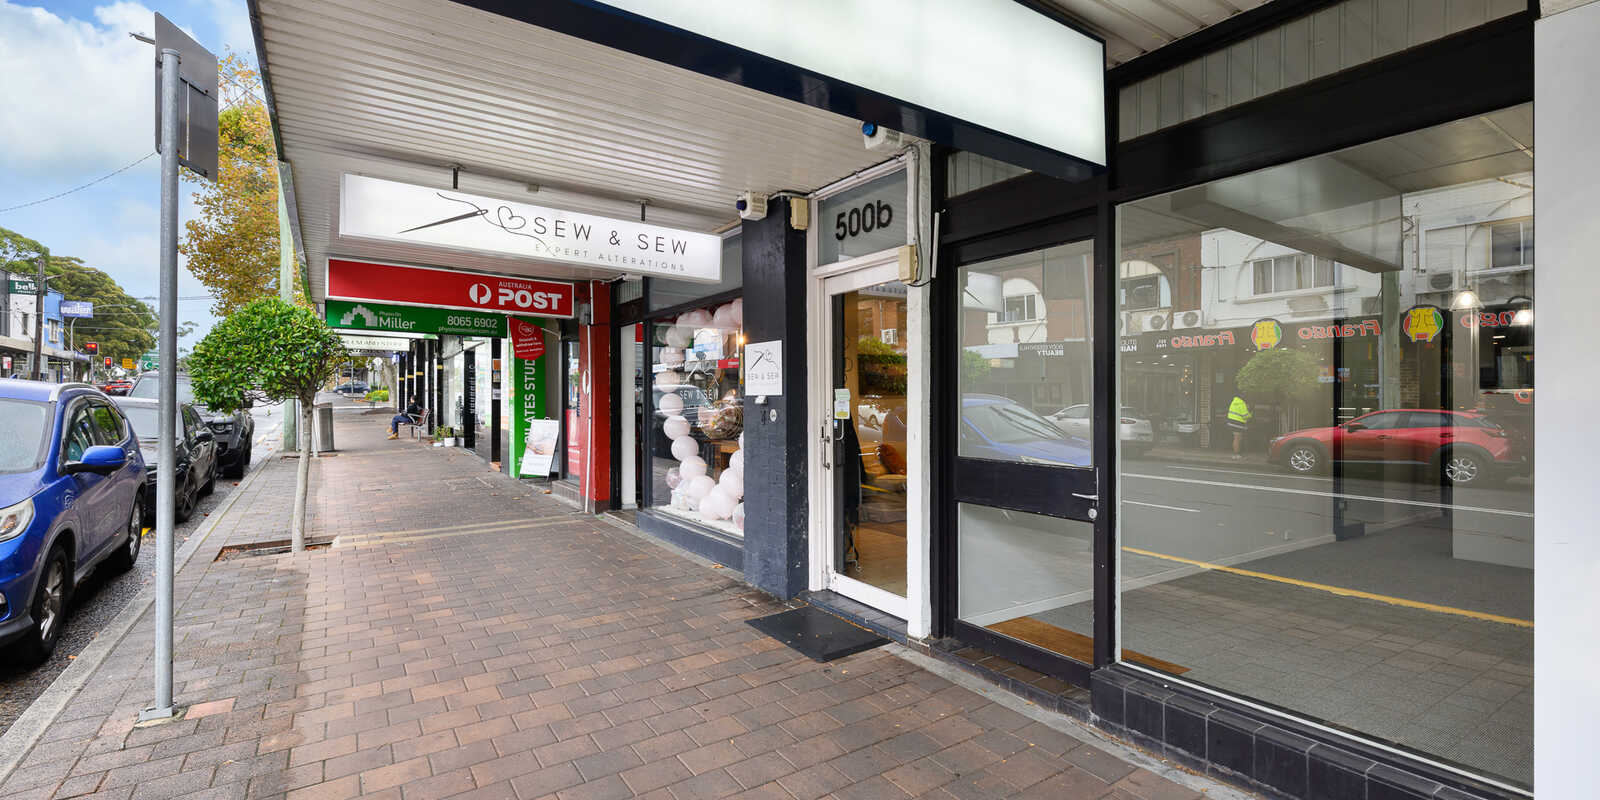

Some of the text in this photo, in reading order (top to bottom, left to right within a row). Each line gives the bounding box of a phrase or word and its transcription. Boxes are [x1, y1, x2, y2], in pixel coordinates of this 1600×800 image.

[835, 200, 893, 241] 500b
[533, 216, 687, 256] SEW & SEW
[535, 243, 685, 271] EXPERT ALTERATIONS
[498, 281, 532, 290] AUSTRALIA
[498, 288, 562, 310] POST
[379, 317, 416, 329] Miller
[447, 316, 498, 330] 8065 6902
[525, 359, 536, 392] STUD
[679, 390, 693, 400] SEW
